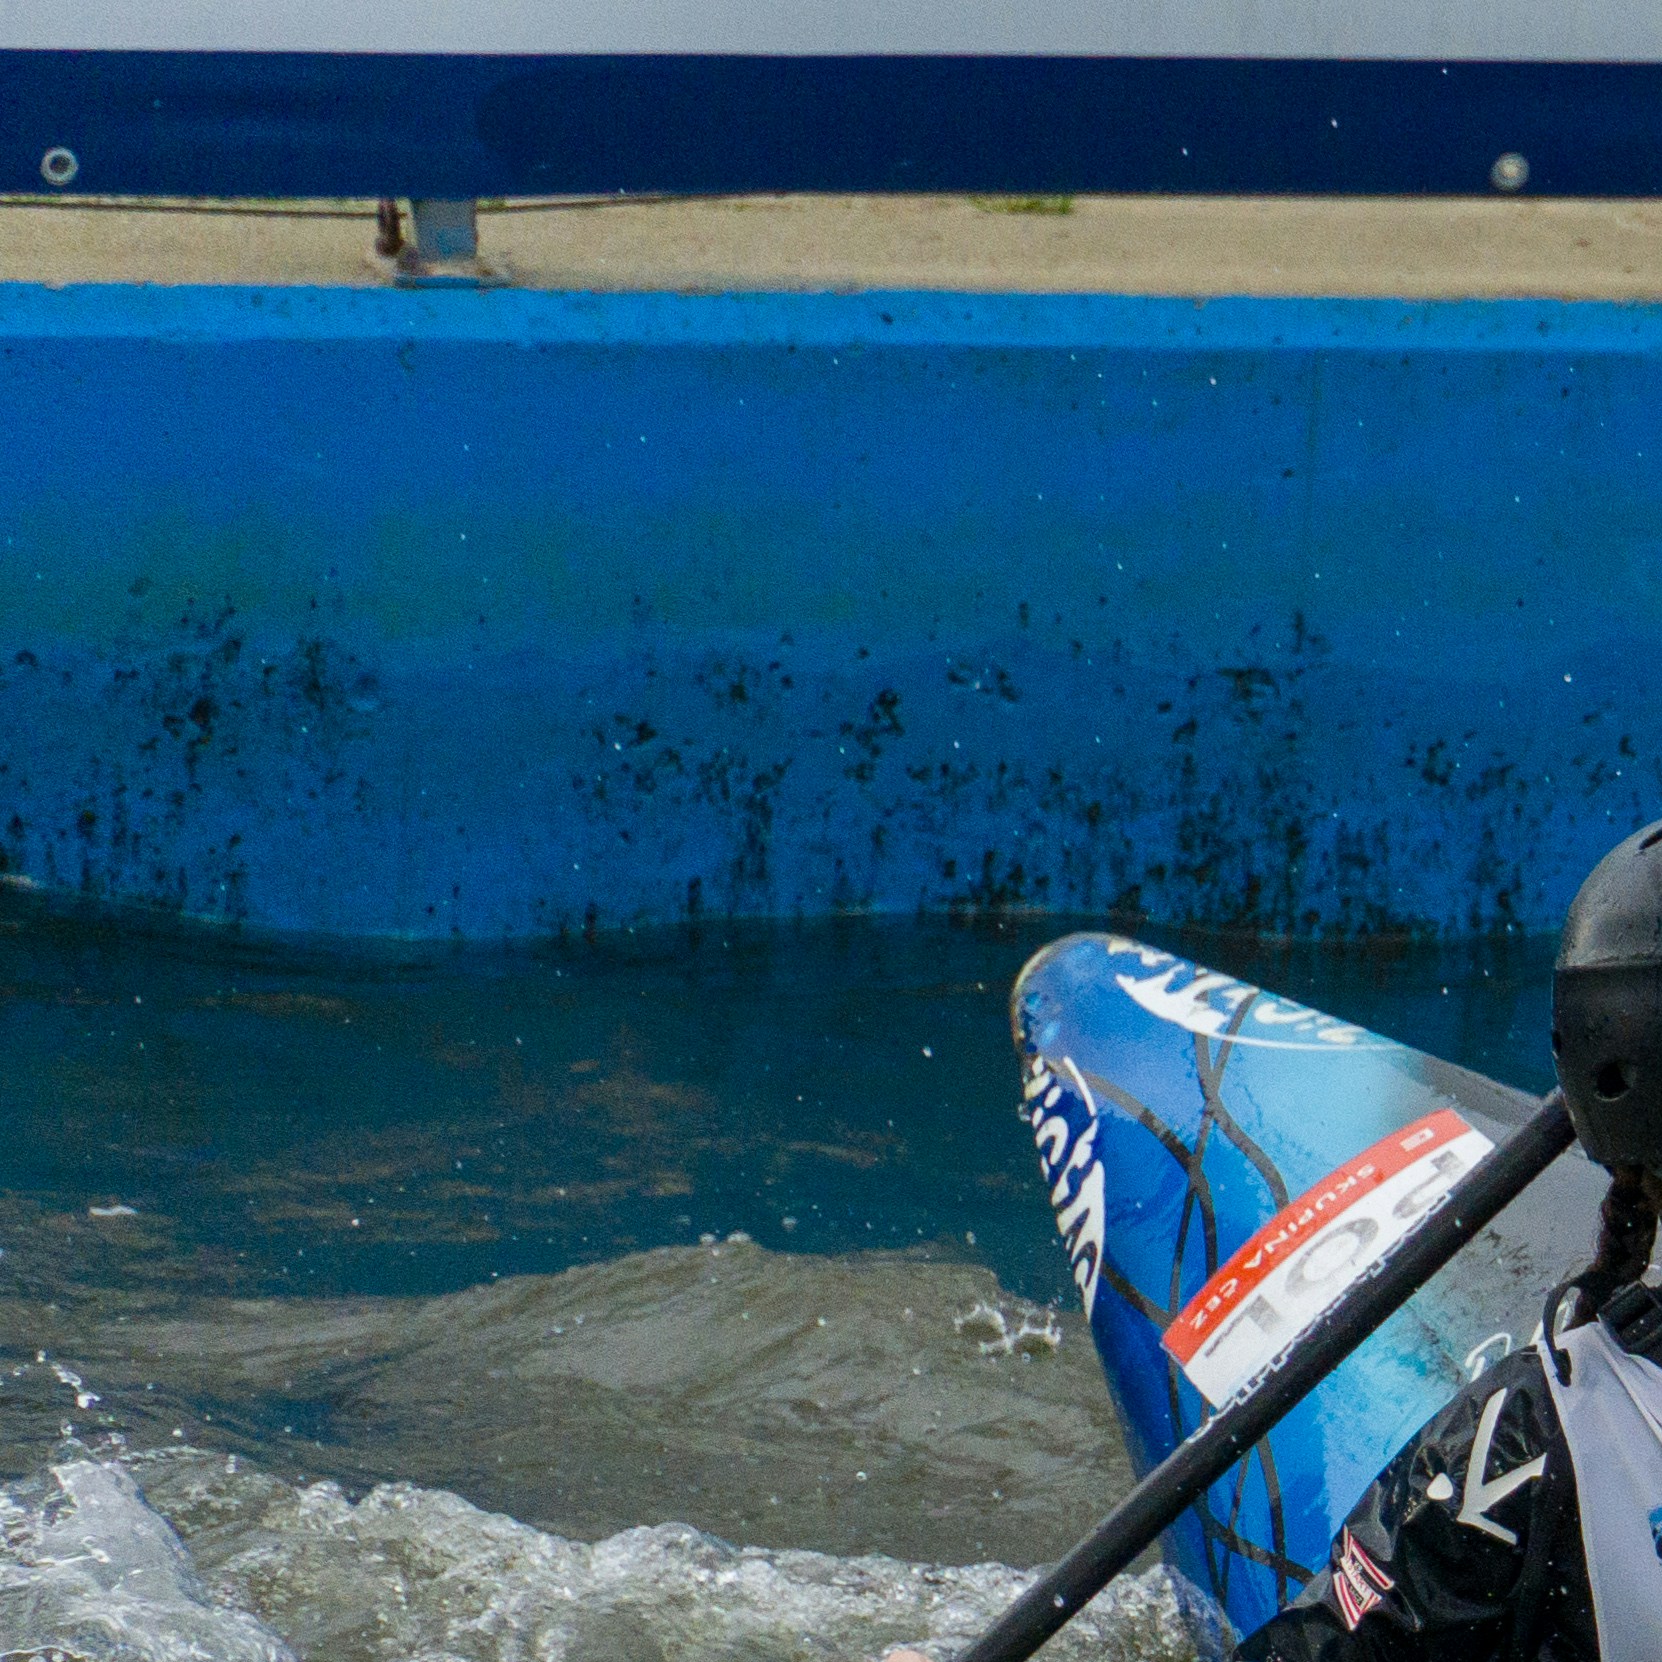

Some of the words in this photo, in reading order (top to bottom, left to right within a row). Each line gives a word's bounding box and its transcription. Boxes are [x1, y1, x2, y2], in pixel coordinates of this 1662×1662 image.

[1203, 1149, 1464, 1360] POL
[1241, 1163, 1376, 1271] SKUPINA
[1188, 1270, 1242, 1331] ČEZ
